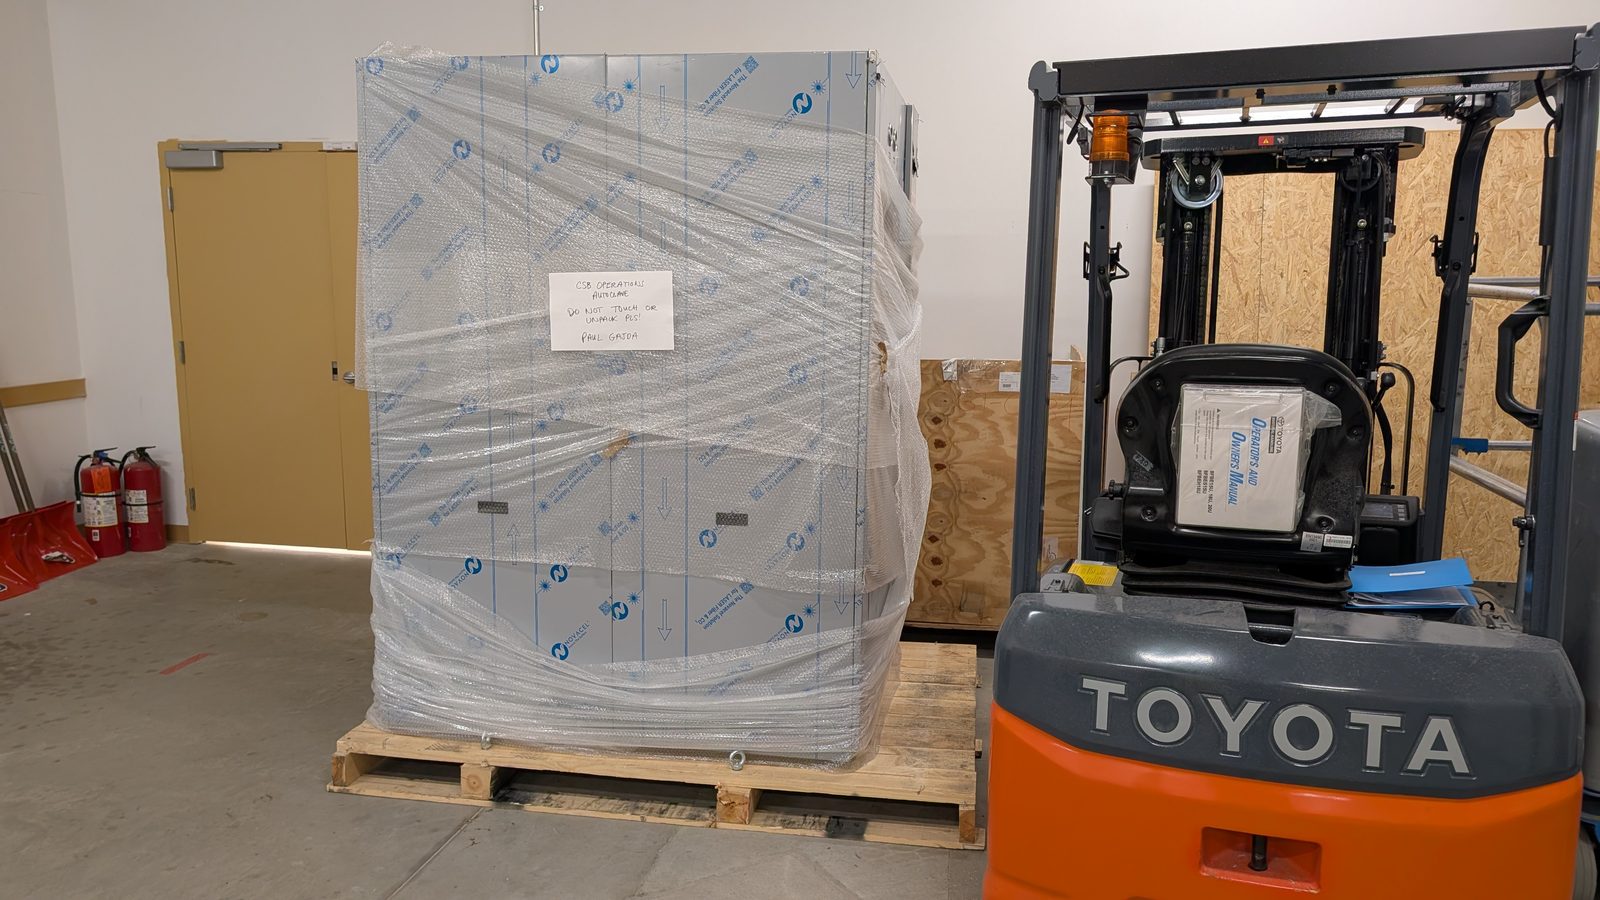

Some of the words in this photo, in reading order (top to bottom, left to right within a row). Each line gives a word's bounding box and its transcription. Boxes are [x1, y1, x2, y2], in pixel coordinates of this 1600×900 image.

[732, 66, 742, 77] for
[737, 73, 748, 84] The
[718, 73, 735, 90] LASER
[707, 87, 721, 102] Fiber
[720, 81, 740, 101] Novacel
[575, 281, 592, 290] CSB
[597, 280, 645, 290] OPERATIONS
[567, 307, 580, 317] DO
[585, 306, 604, 315] NOT
[611, 305, 638, 313] TOUCH
[585, 316, 618, 324] UNPACK
[625, 313, 641, 322] PLS!
[581, 332, 604, 343] PAUL
[1249, 417, 1267, 467] OPERATOR'S
[1275, 427, 1283, 453] TOYOTA
[1229, 431, 1247, 469] OWNER'S
[1248, 468, 1258, 486] AND
[1228, 470, 1244, 506] MANUAL
[716, 592, 731, 607] LASER
[729, 587, 738, 596] for
[733, 593, 743, 603] The
[706, 604, 719, 616] Fiber
[718, 600, 735, 617] Novacel
[702, 613, 720, 631] Solution
[563, 621, 590, 646] NOVACEL
[1080, 677, 1473, 777] TOYOTA
